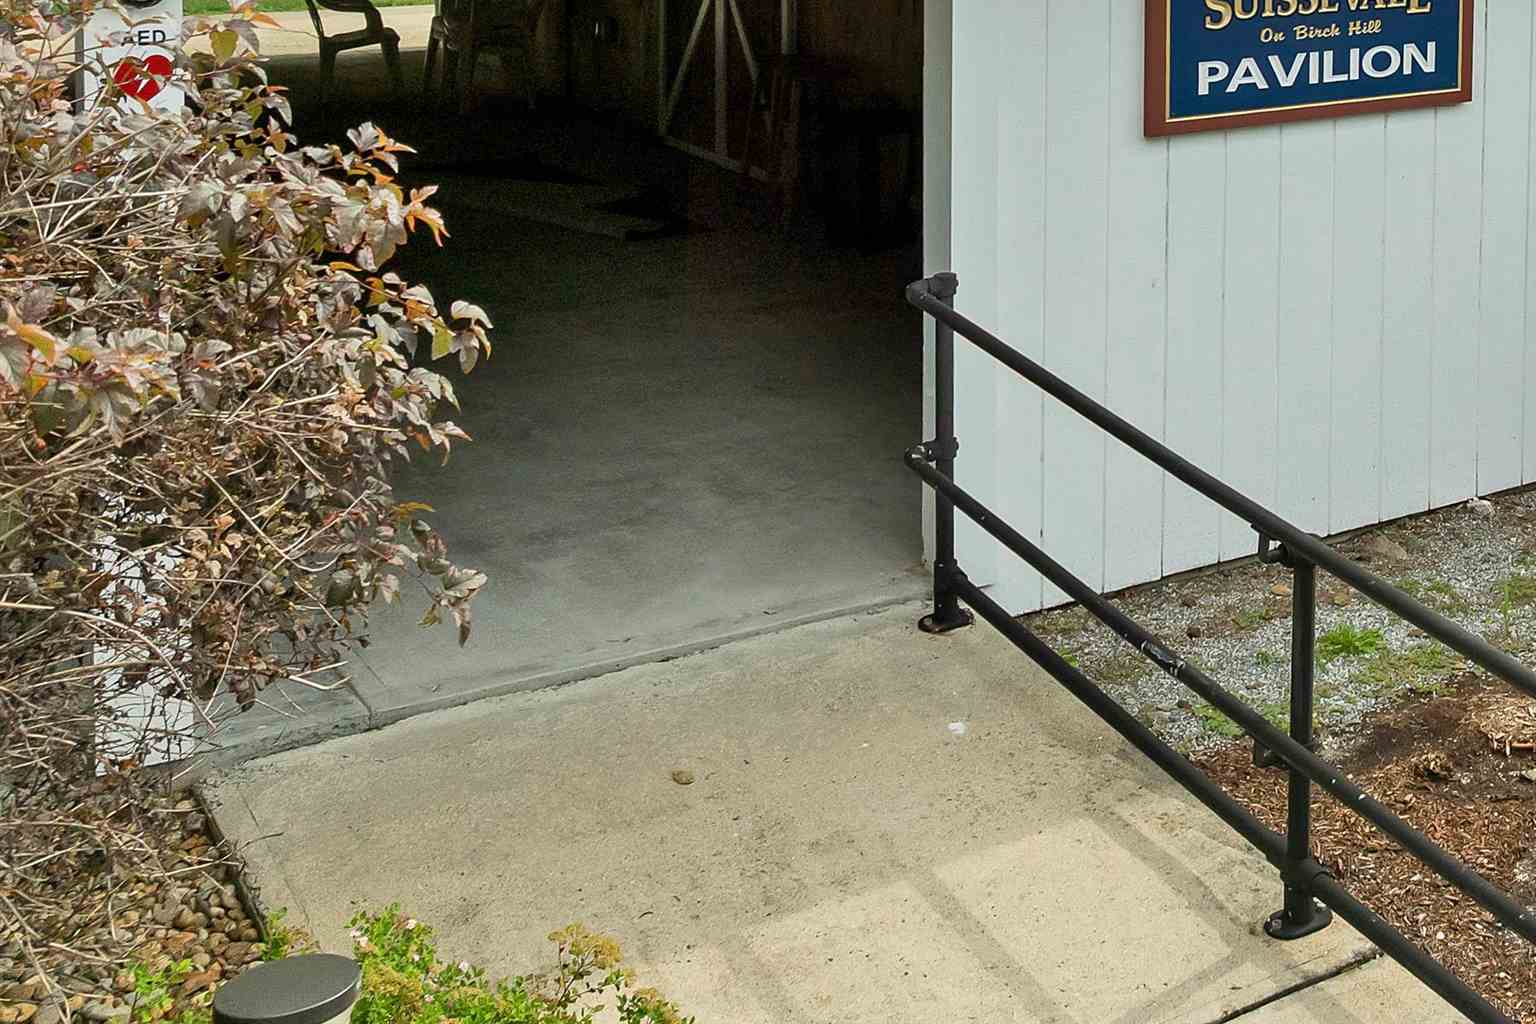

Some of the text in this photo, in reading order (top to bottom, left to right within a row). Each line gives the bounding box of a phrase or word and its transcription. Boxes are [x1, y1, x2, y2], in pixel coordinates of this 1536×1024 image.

[1259, 18, 1382, 43] On Birch Hill
[1197, 41, 1436, 96] PAVILION
